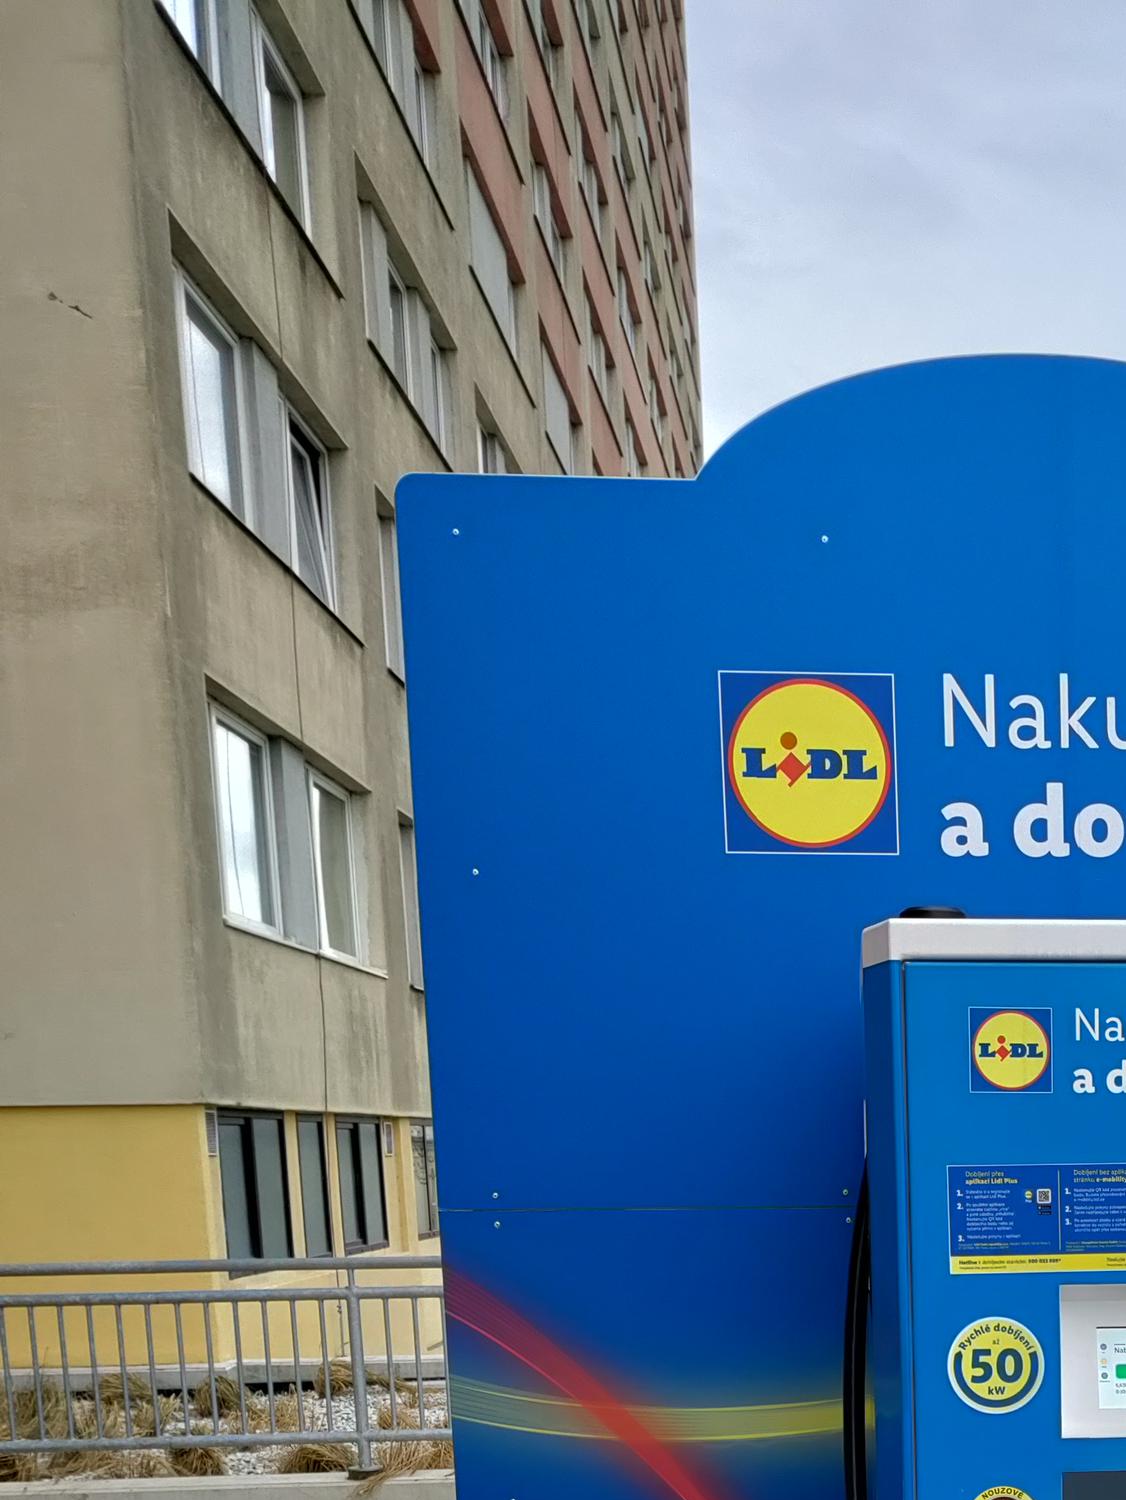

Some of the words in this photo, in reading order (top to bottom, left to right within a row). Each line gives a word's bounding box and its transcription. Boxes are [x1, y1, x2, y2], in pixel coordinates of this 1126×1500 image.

[940, 800, 989, 859] a
[1072, 1066, 1095, 1094] a
[958, 1324, 991, 1351] Rychlé
[993, 1322, 1034, 1351] dobíjení
[971, 1347, 1024, 1384] 50
[987, 1386, 1006, 1395] kW
